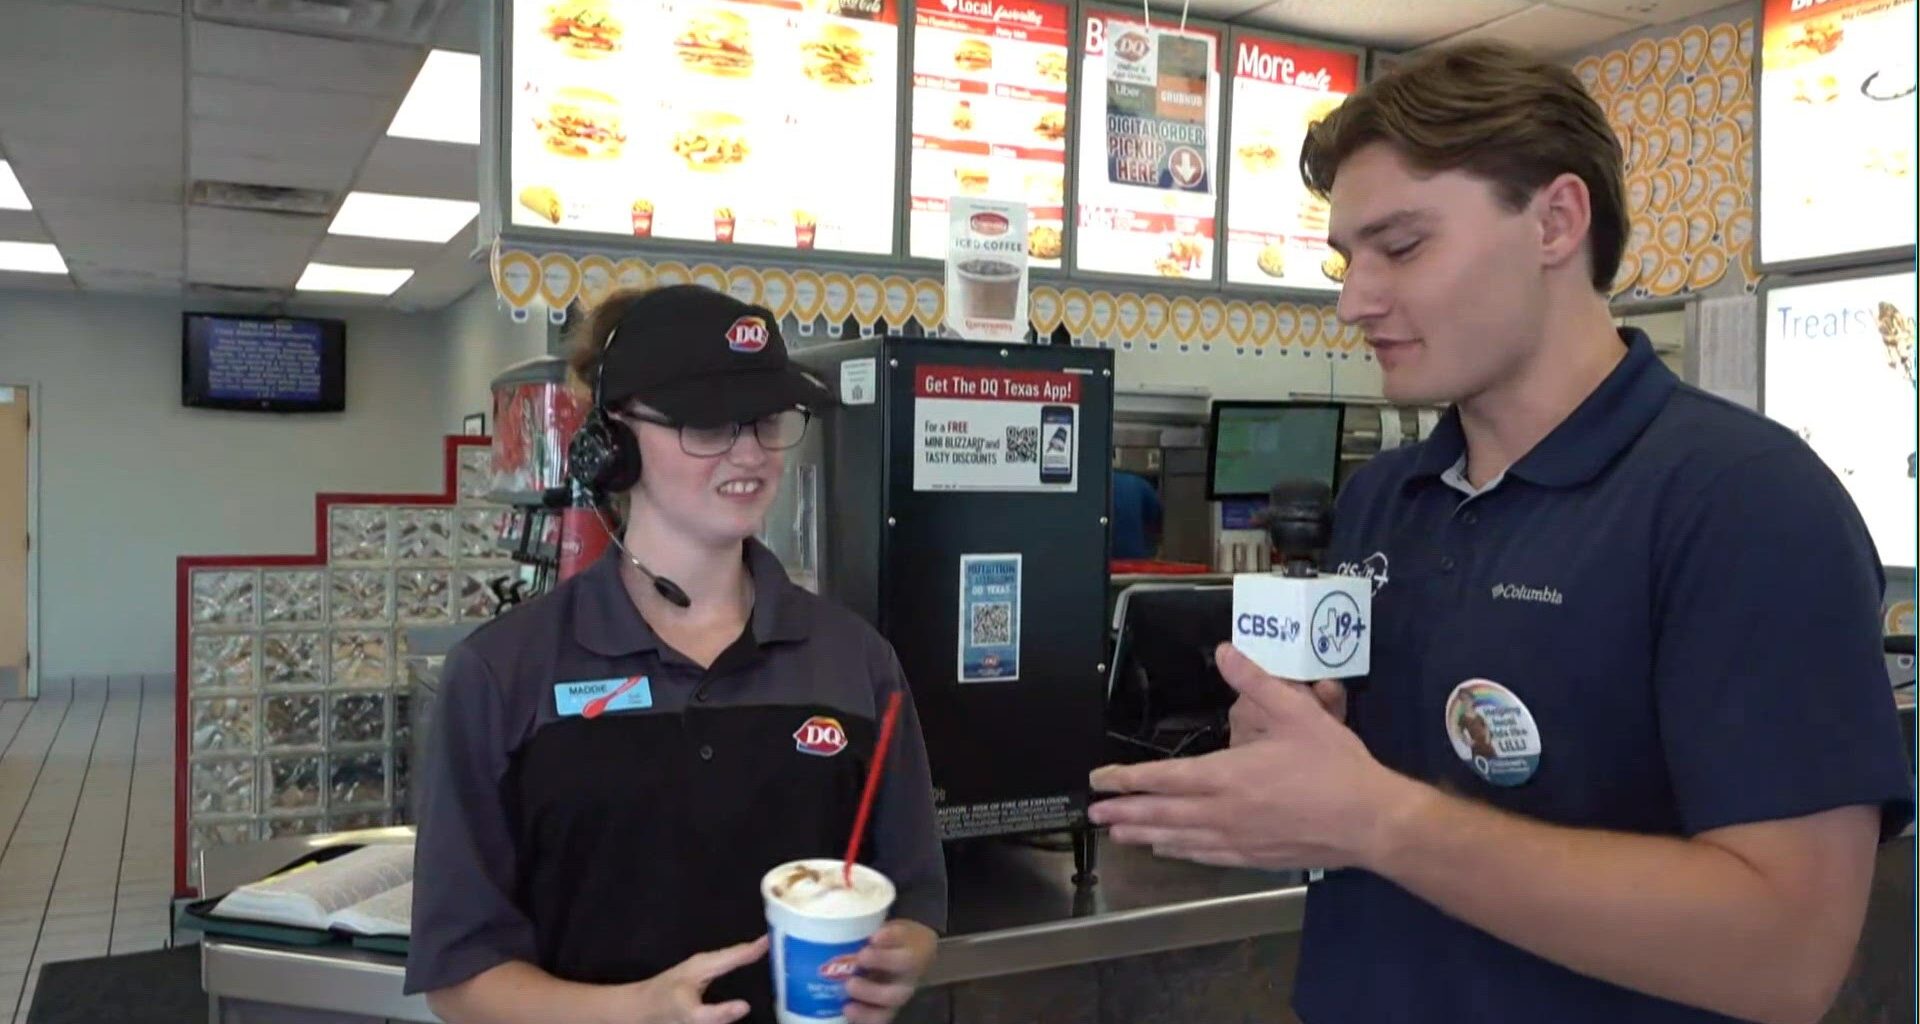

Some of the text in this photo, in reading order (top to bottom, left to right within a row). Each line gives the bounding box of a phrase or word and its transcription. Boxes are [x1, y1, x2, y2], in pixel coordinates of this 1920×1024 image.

[958, 0, 993, 16] Local
[1237, 42, 1295, 85] More
[1115, 82, 1141, 98] Uber
[1108, 115, 1205, 145] DIGITAL ORDER
[1109, 137, 1166, 161] PICKUP
[1117, 158, 1159, 185] HERE
[955, 237, 1023, 252] ICED COFFEE
[1778, 305, 1867, 340] Treats
[736, 324, 764, 344] DQ
[925, 375, 1072, 401] Get The DQ Texas App!
[925, 420, 968, 434] For a FREE
[925, 436, 943, 448] MINI
[985, 438, 1000, 449] and
[925, 452, 998, 465] TASTY DISCOUNTS
[986, 584, 1011, 595] TEXAS
[1503, 583, 1563, 605] Columbia
[1237, 613, 1279, 639] CBS
[569, 684, 607, 695] MADDIE
[806, 725, 842, 747] DQ
